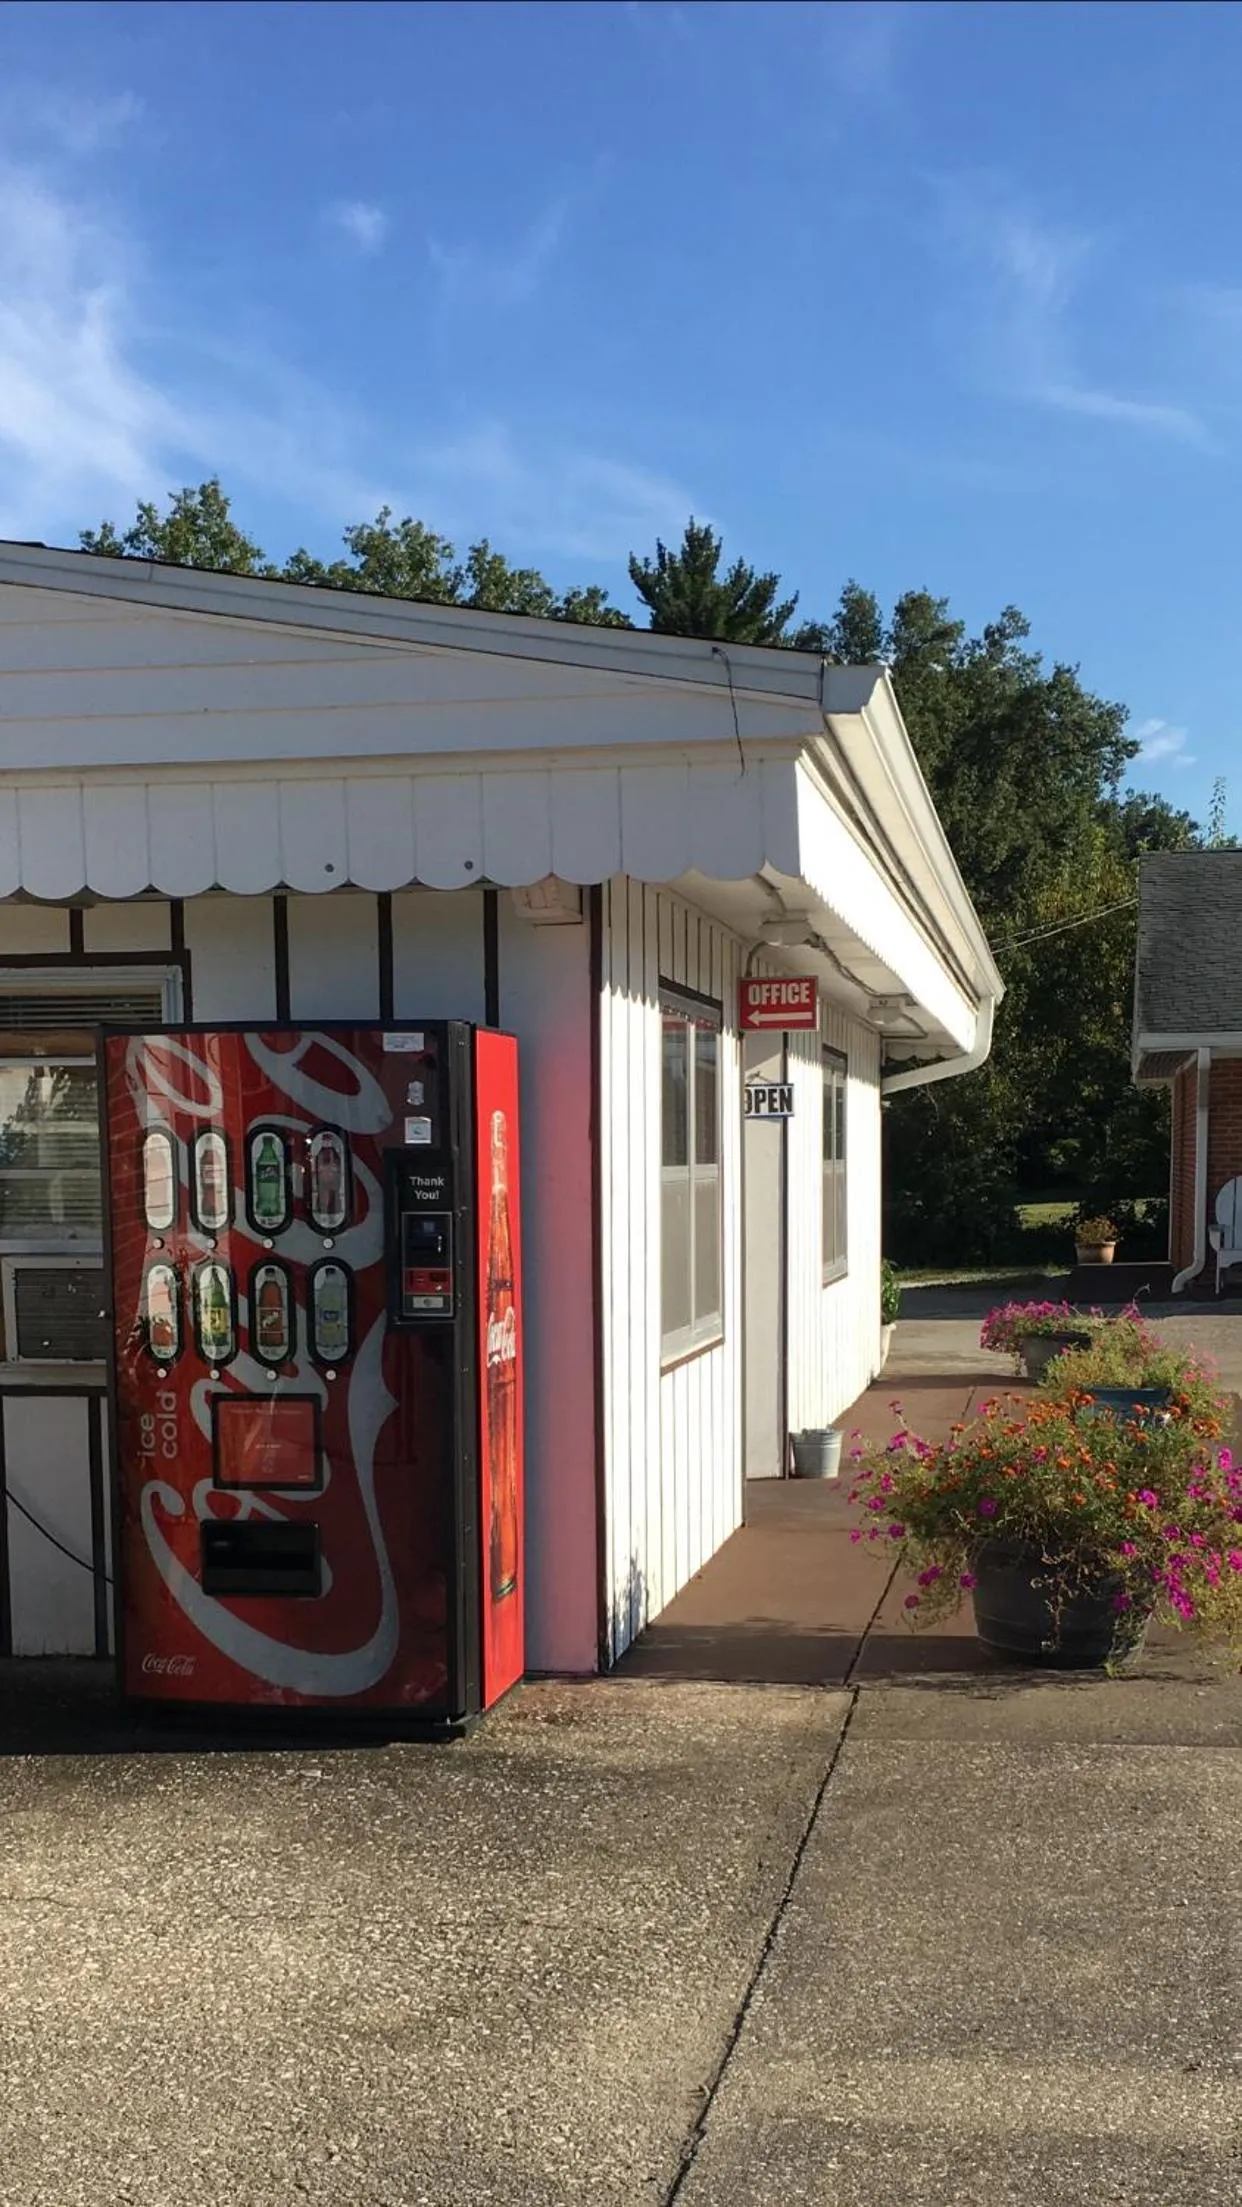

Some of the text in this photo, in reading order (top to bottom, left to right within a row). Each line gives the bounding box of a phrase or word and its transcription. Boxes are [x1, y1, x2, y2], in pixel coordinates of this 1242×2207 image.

[748, 982, 811, 1005] OFFICE
[409, 1176, 444, 1187] Thank
[414, 1189, 440, 1201] You!
[137, 1413, 156, 1458] ice
[155, 1391, 178, 1460] cold
